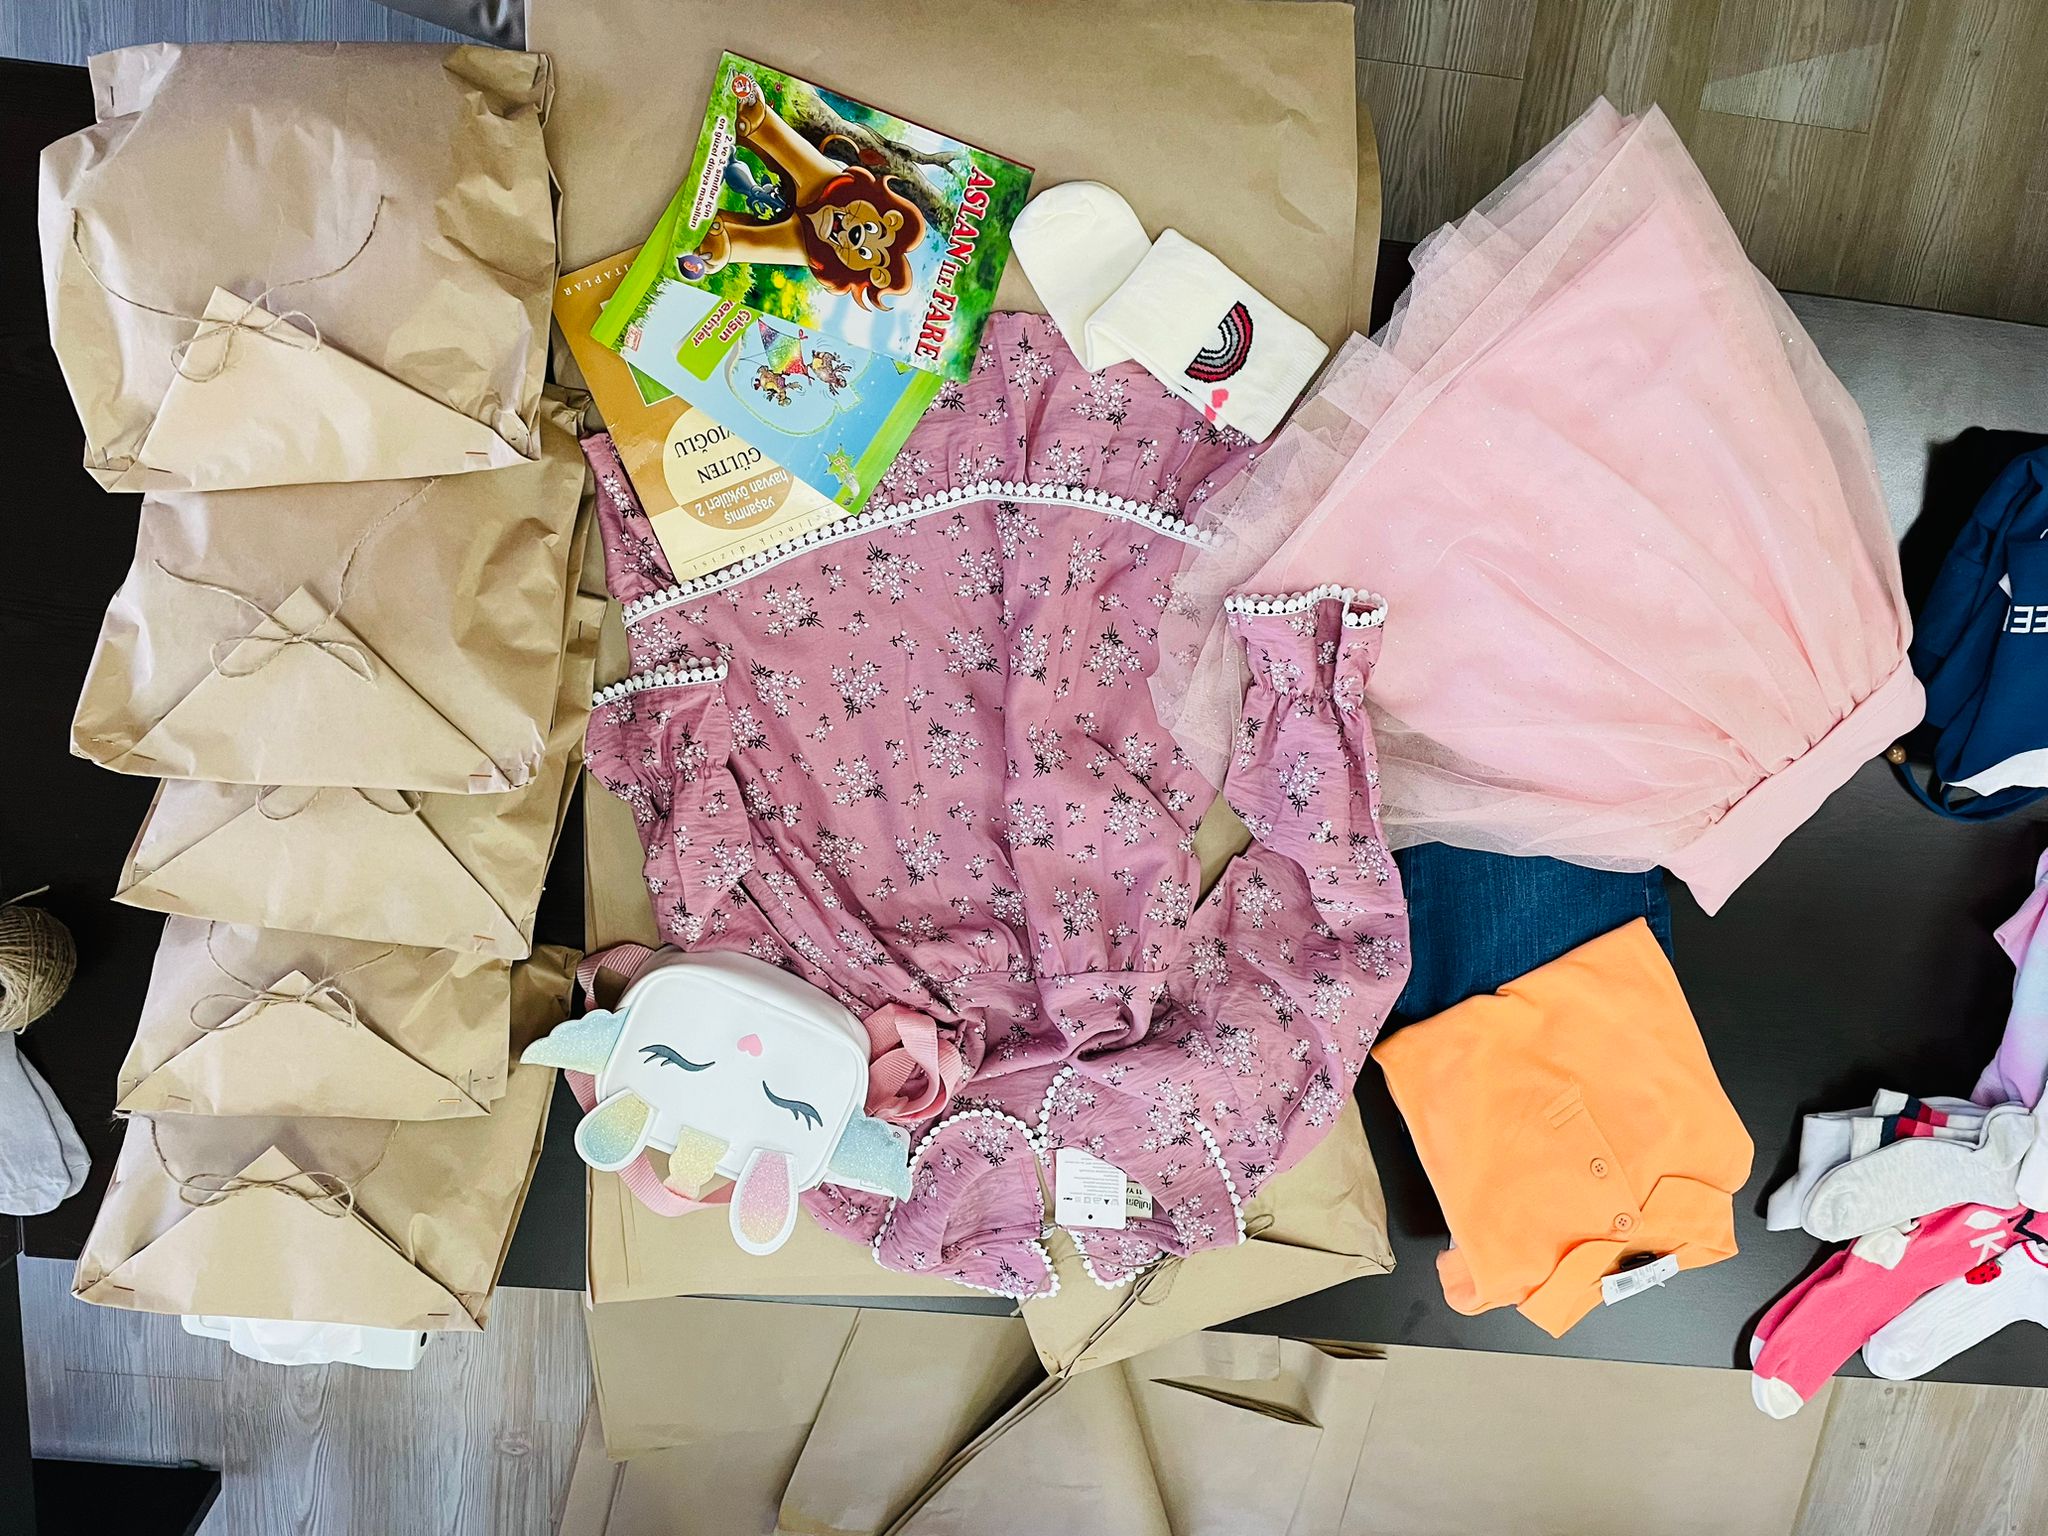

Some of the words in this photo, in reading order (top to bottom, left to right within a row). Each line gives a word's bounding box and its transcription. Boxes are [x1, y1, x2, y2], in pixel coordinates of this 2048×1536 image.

[719, 119, 725, 129] en
[721, 146, 727, 156] ve
[946, 166, 995, 264] ASLAN
[718, 309, 751, 343] Çılgın
[915, 290, 957, 361] FARE
[697, 446, 761, 482] GÜLTEN
[749, 469, 789, 494] hayvan
[694, 503, 705, 517] 2
[706, 485, 749, 514] öyküleri
[723, 494, 775, 525] yaşanmış
[692, 545, 746, 571] dizisi
[2003, 605, 2048, 633] EE
